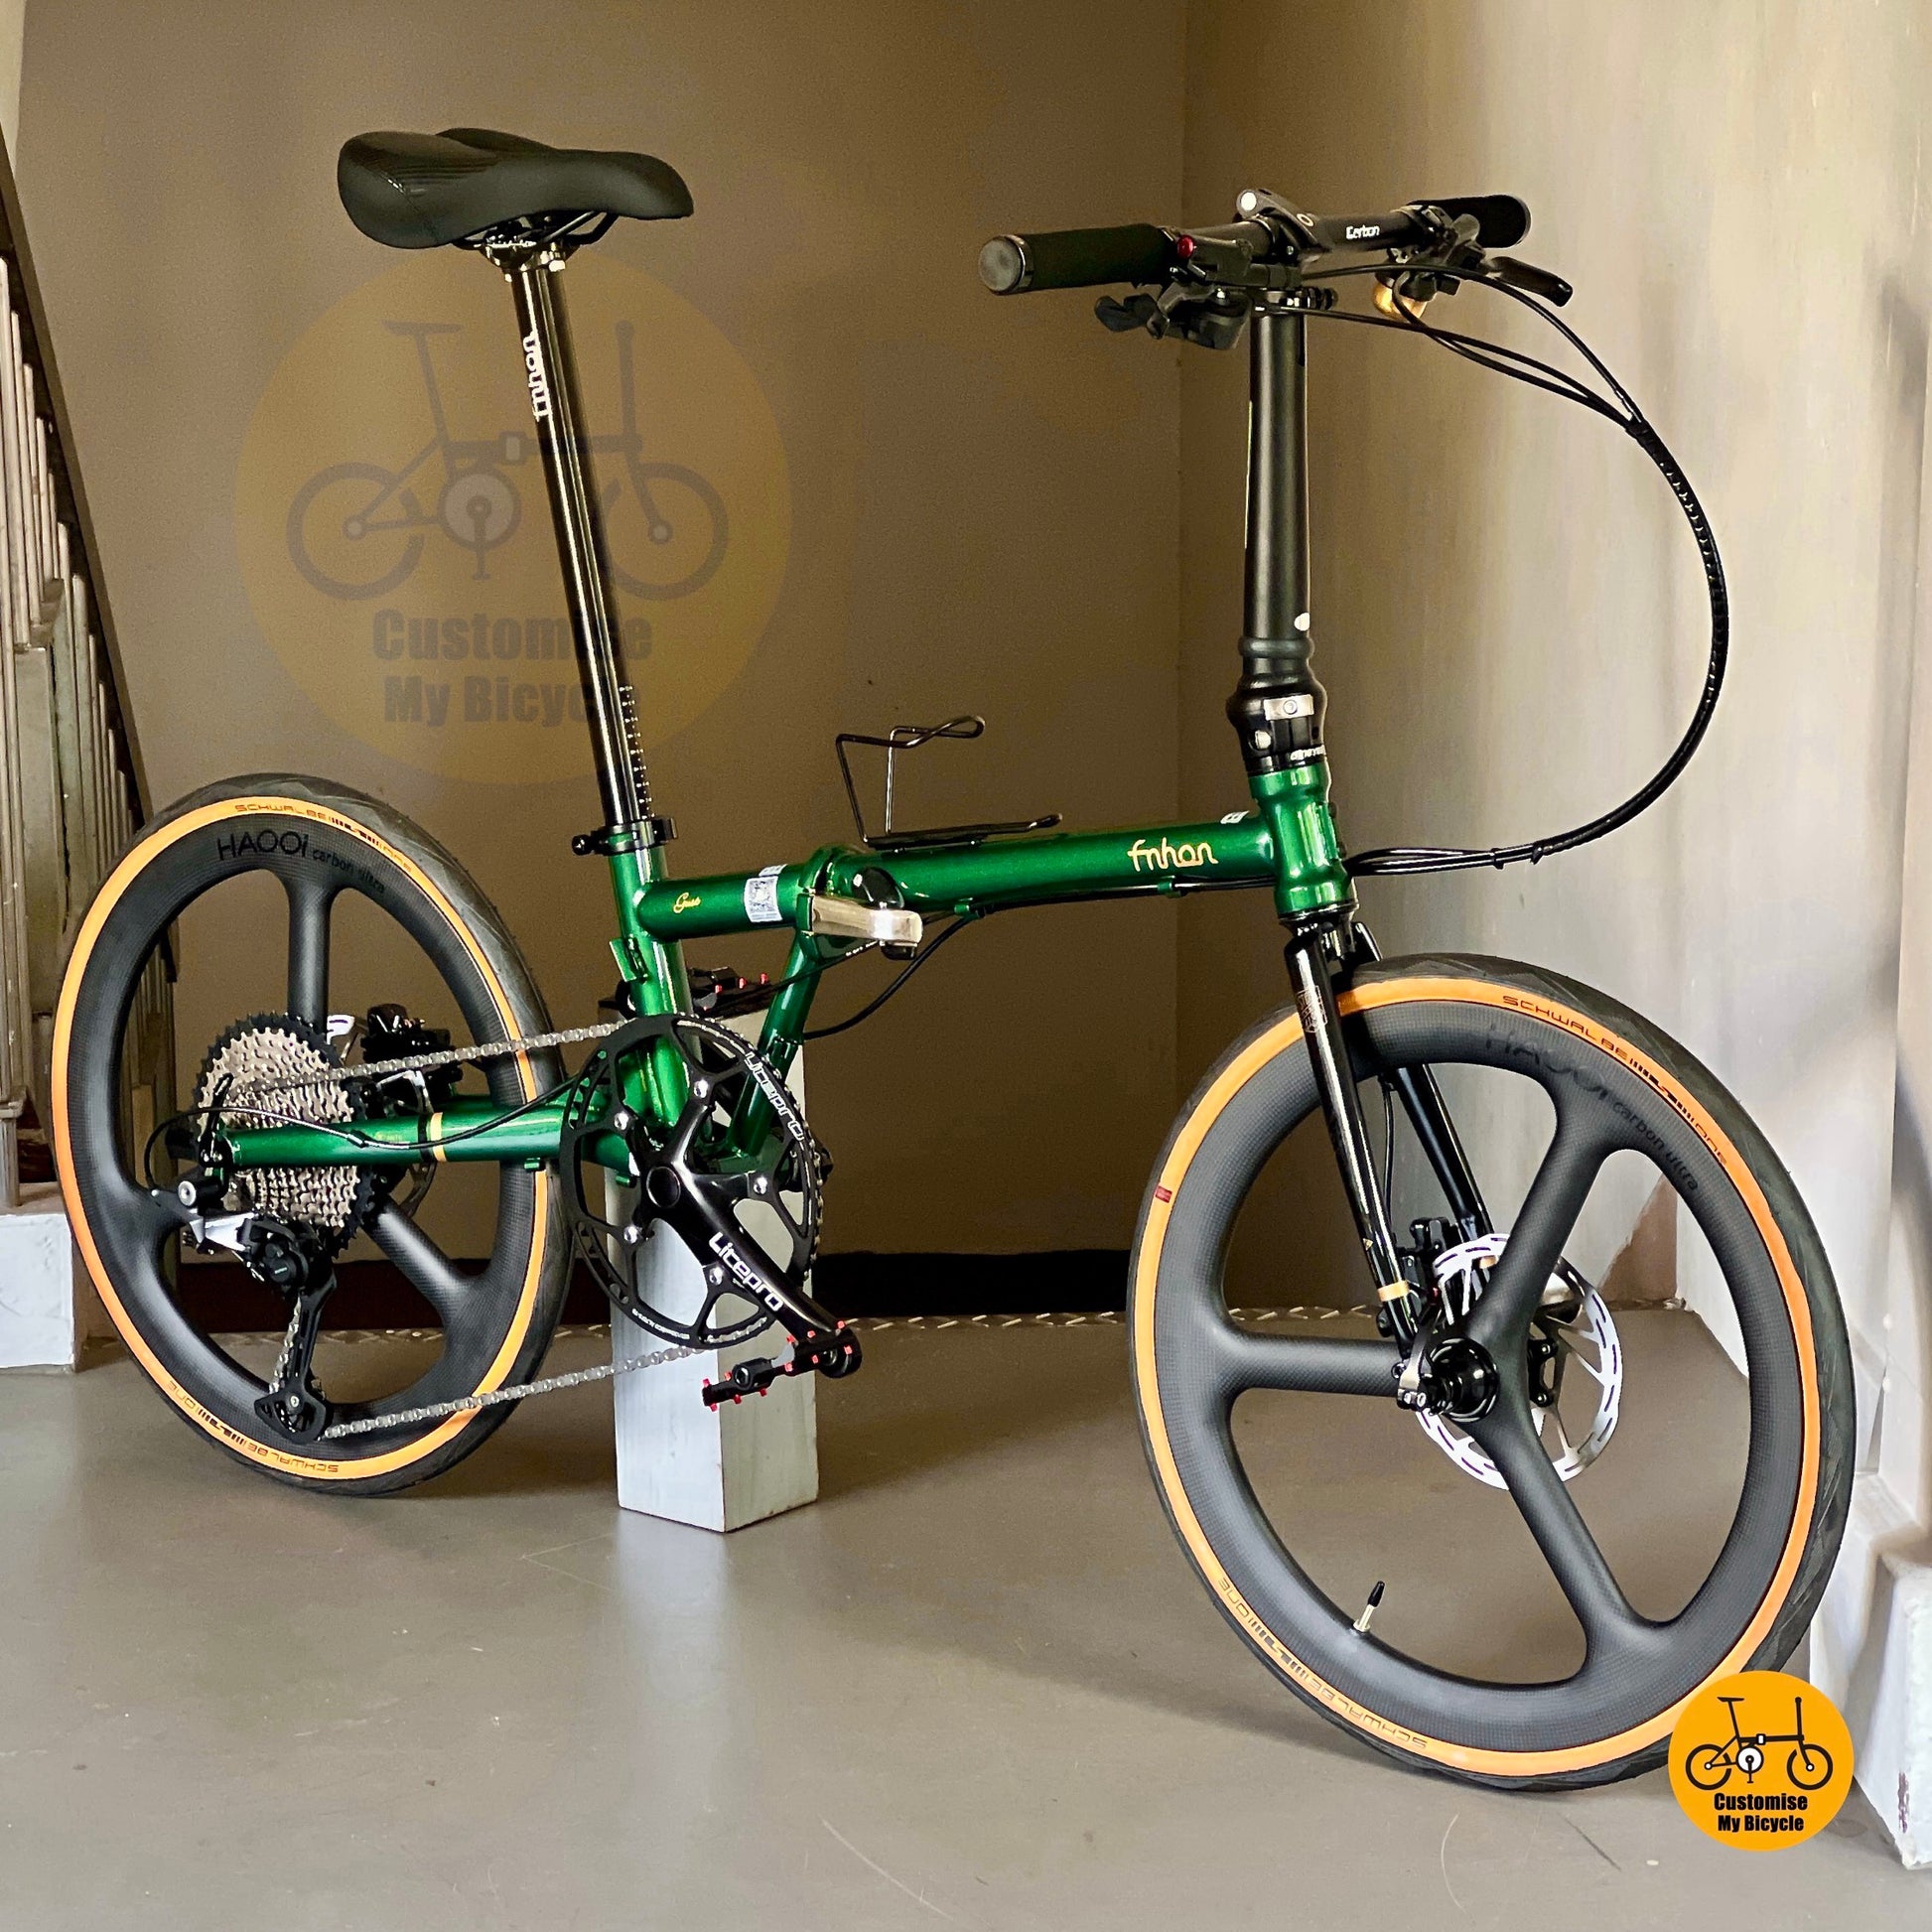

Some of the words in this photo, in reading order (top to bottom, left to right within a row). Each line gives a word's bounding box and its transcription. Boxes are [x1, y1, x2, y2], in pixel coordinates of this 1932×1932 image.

[234, 803, 327, 822] SCHWALBE
[1127, 837, 1219, 872] fnhan
[1503, 995, 1628, 1061] SCHWALBE
[1612, 1101, 1665, 1150] carbon
[1665, 1151, 1699, 1191] ultra
[709, 1231, 784, 1311] Litepro
[1308, 1677, 1429, 1749] SCHWALBE
